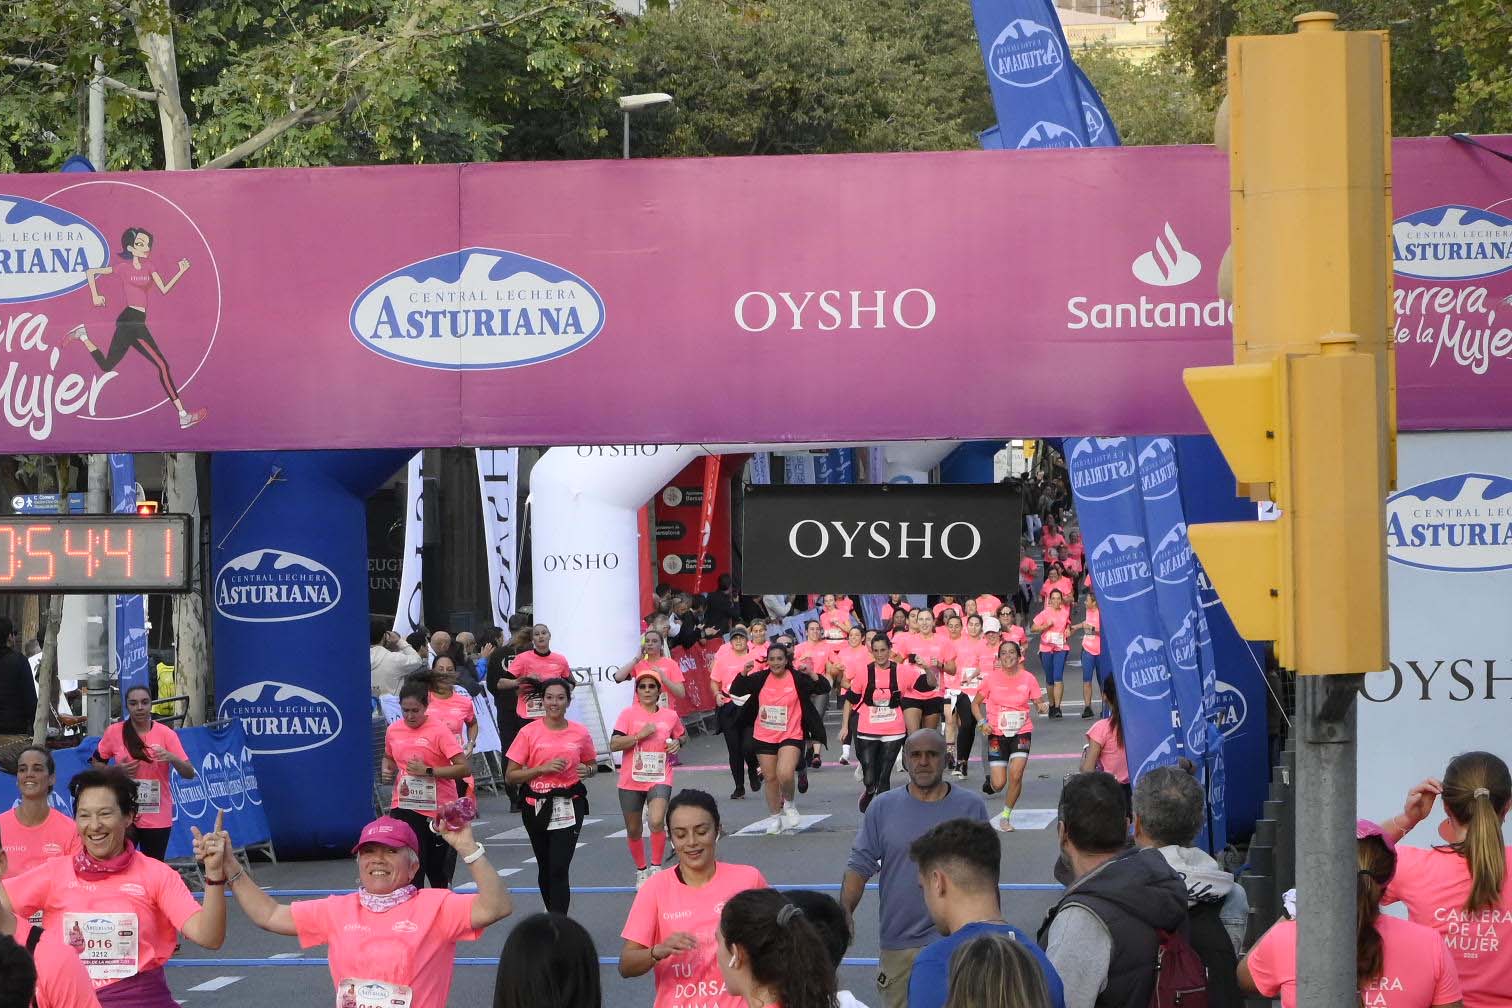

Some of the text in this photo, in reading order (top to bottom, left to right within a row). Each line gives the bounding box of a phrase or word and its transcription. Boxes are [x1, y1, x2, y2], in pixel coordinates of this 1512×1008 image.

[12, 231, 85, 242] LECHERA
[1407, 231, 1458, 239] CENTRAL
[409, 289, 577, 304] CENTRAL LECHERA
[1393, 286, 1488, 315] arrera
[369, 296, 586, 340] ASTURIANA
[734, 288, 937, 332] OYSHO
[1067, 296, 1233, 329] Santand
[1416, 310, 1512, 375] la Muje
[1413, 509, 1481, 518] CENTRAL
[789, 518, 982, 561] OYSHO
[544, 553, 619, 571] OYSHO
[278, 574, 327, 582] LECHERA
[219, 579, 332, 606] ASTURIANA
[1358, 659, 1512, 703] OYSH
[226, 712, 332, 735] TURIANA
[1448, 923, 1497, 937] DE LA
[87, 939, 112, 949] 016
[1444, 936, 1499, 951] MUJER
[671, 963, 692, 979] TU
[674, 980, 728, 999] DORSA
[1365, 992, 1386, 1005] LA
